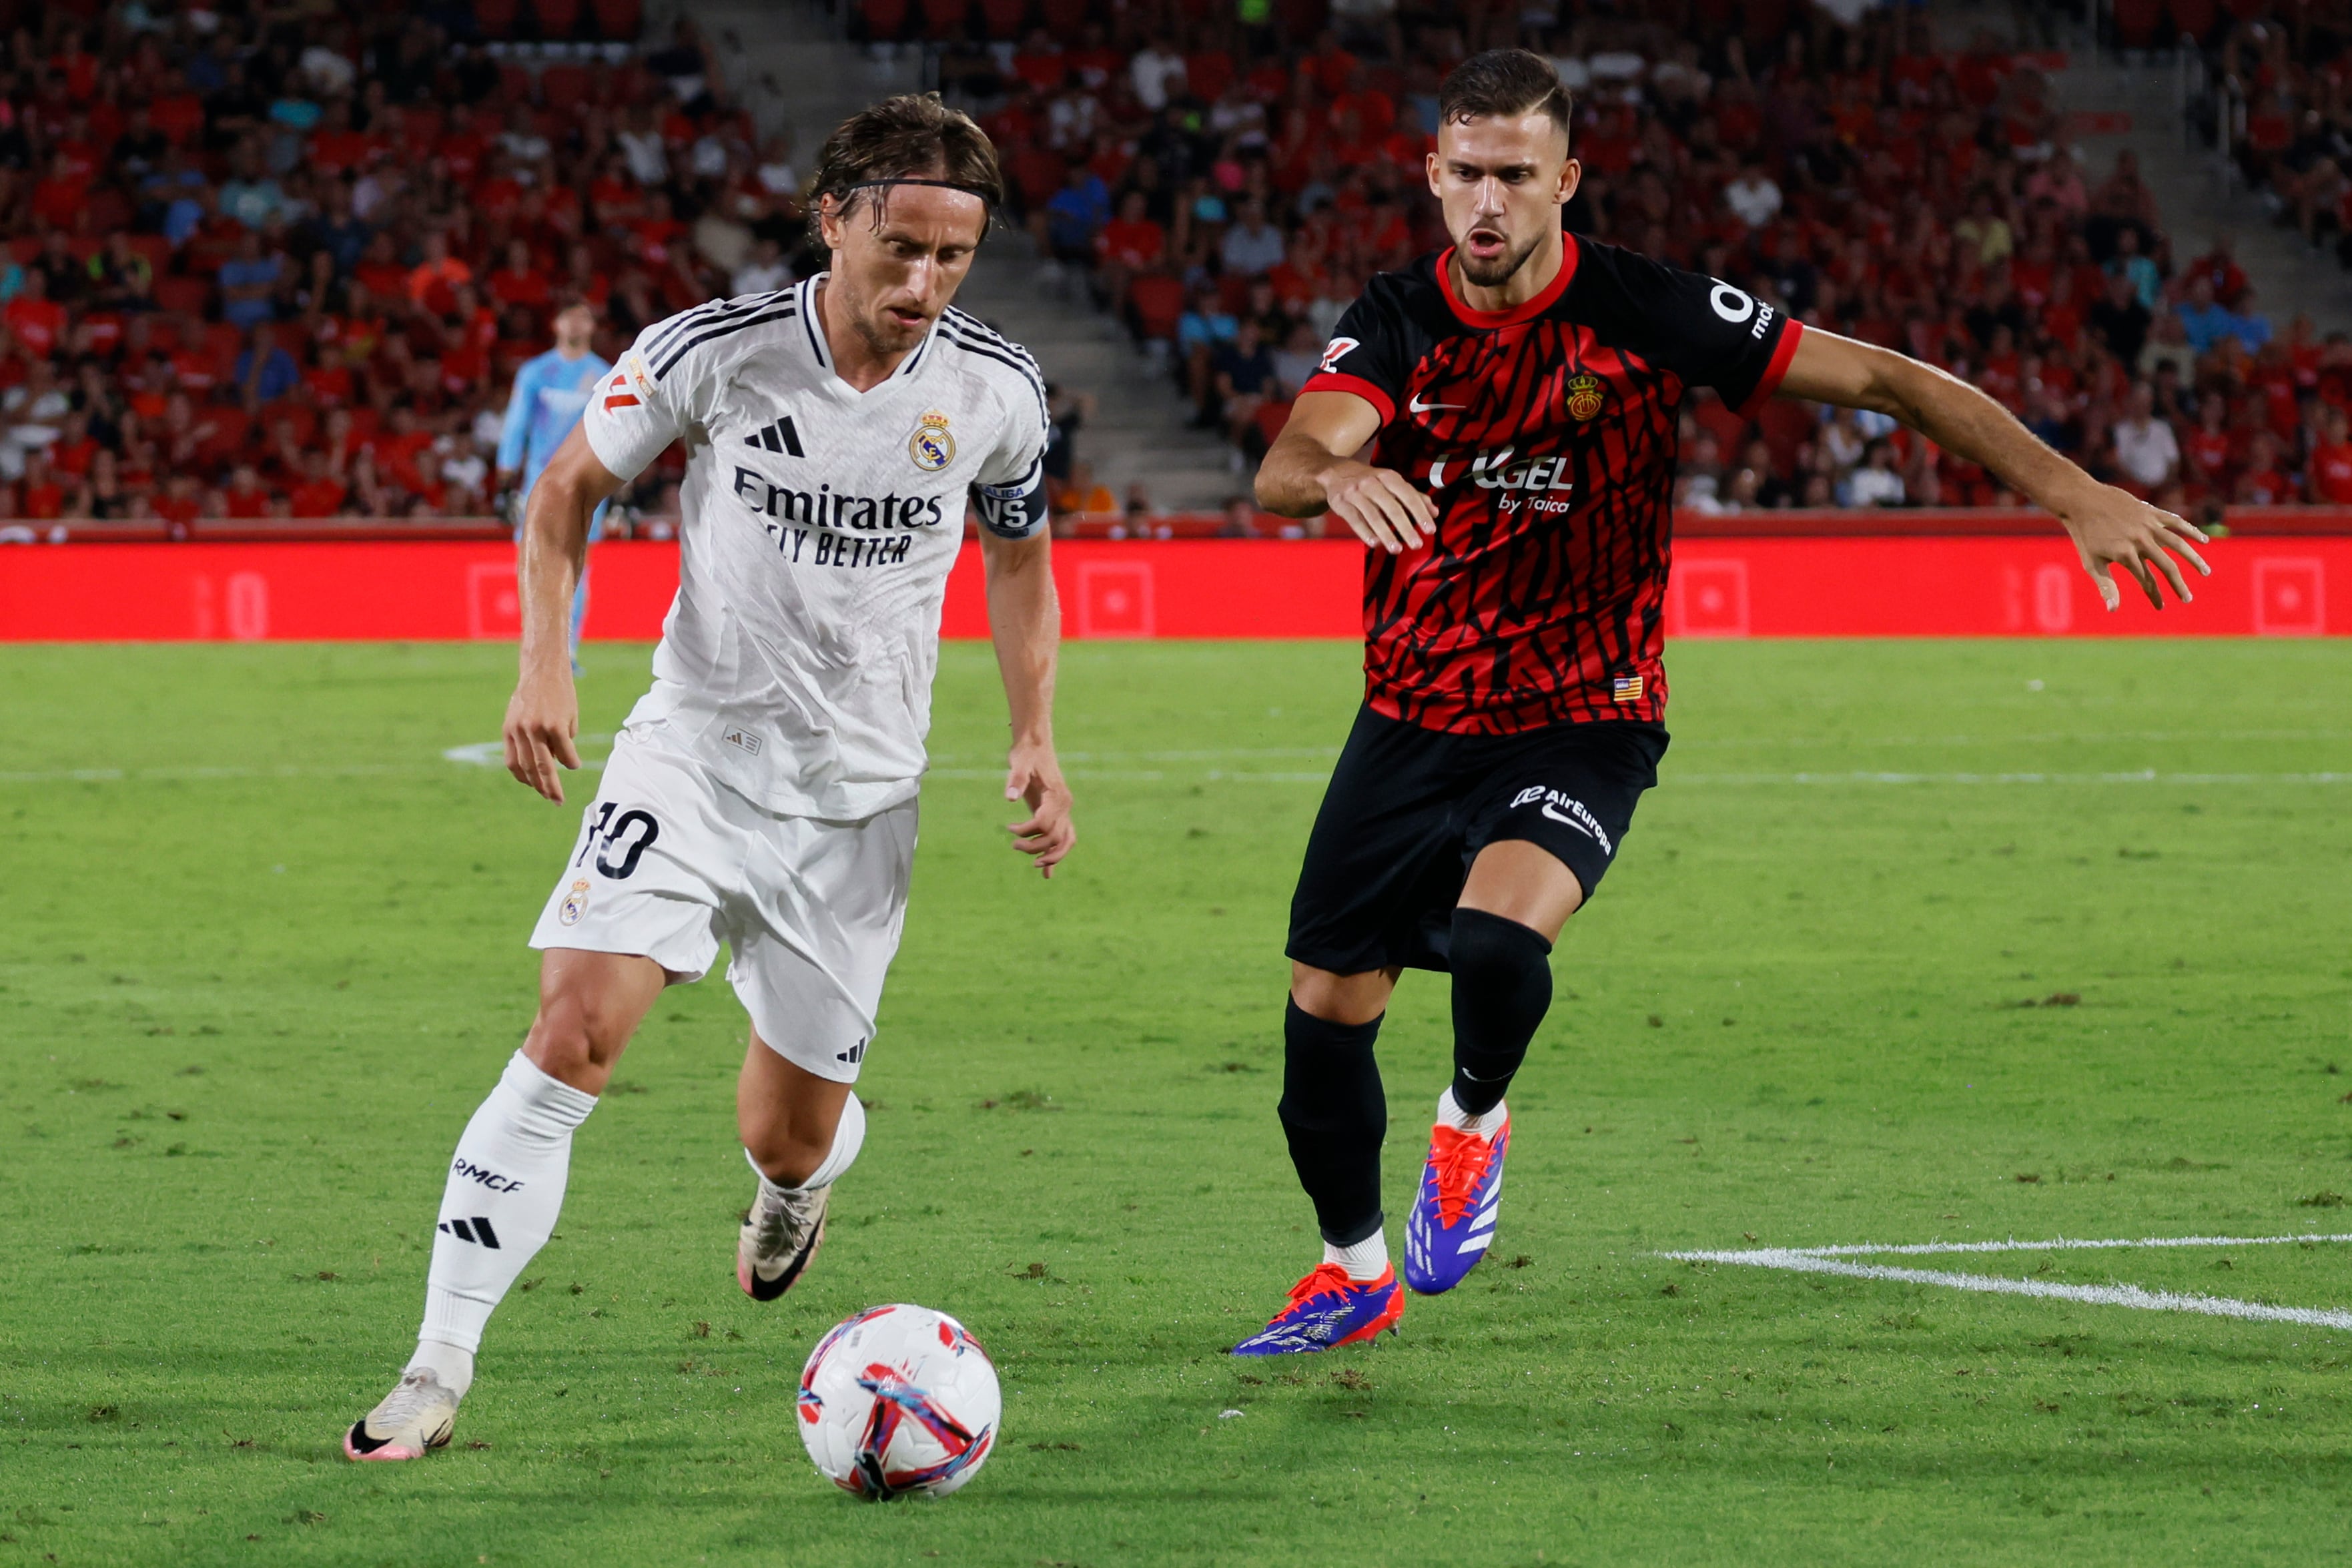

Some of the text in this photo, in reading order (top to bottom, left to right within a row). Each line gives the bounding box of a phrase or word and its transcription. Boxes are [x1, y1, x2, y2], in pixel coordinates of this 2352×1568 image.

[734, 465, 942, 530] Emirates
[981, 494, 1028, 528] VS
[1499, 492, 1570, 514] by Taica
[815, 532, 912, 567] BETTER
[576, 802, 659, 879] 10
[452, 1158, 525, 1193] RMCF
